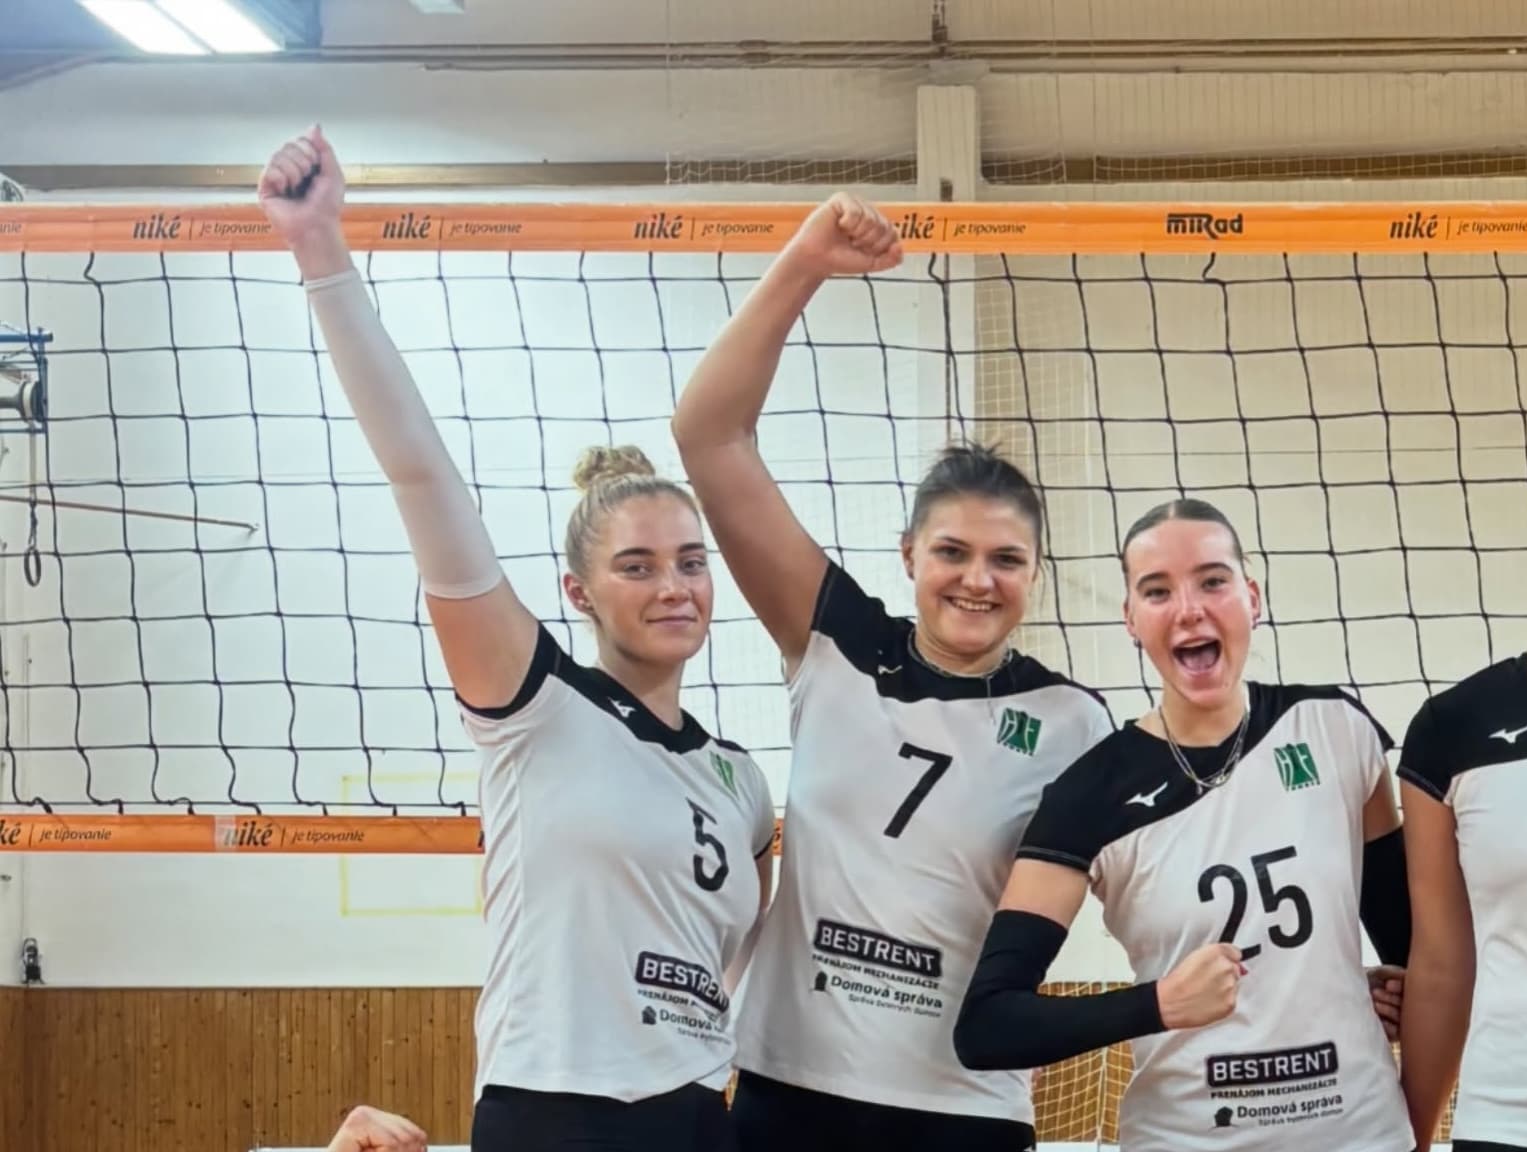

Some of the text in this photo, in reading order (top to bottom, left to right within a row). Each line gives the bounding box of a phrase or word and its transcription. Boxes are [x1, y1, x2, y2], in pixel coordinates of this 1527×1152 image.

[133, 213, 182, 240] niké
[382, 212, 432, 239] niké
[633, 213, 684, 239] niké
[1390, 212, 1438, 239] niké
[884, 742, 953, 838] 7
[685, 796, 729, 892] 5
[1197, 845, 1314, 962] 25
[820, 926, 935, 972] BESTRENT
[831, 974, 890, 998] Domová
[1213, 1048, 1331, 1082] BESTRENT
[1237, 1101, 1297, 1119] Domová
